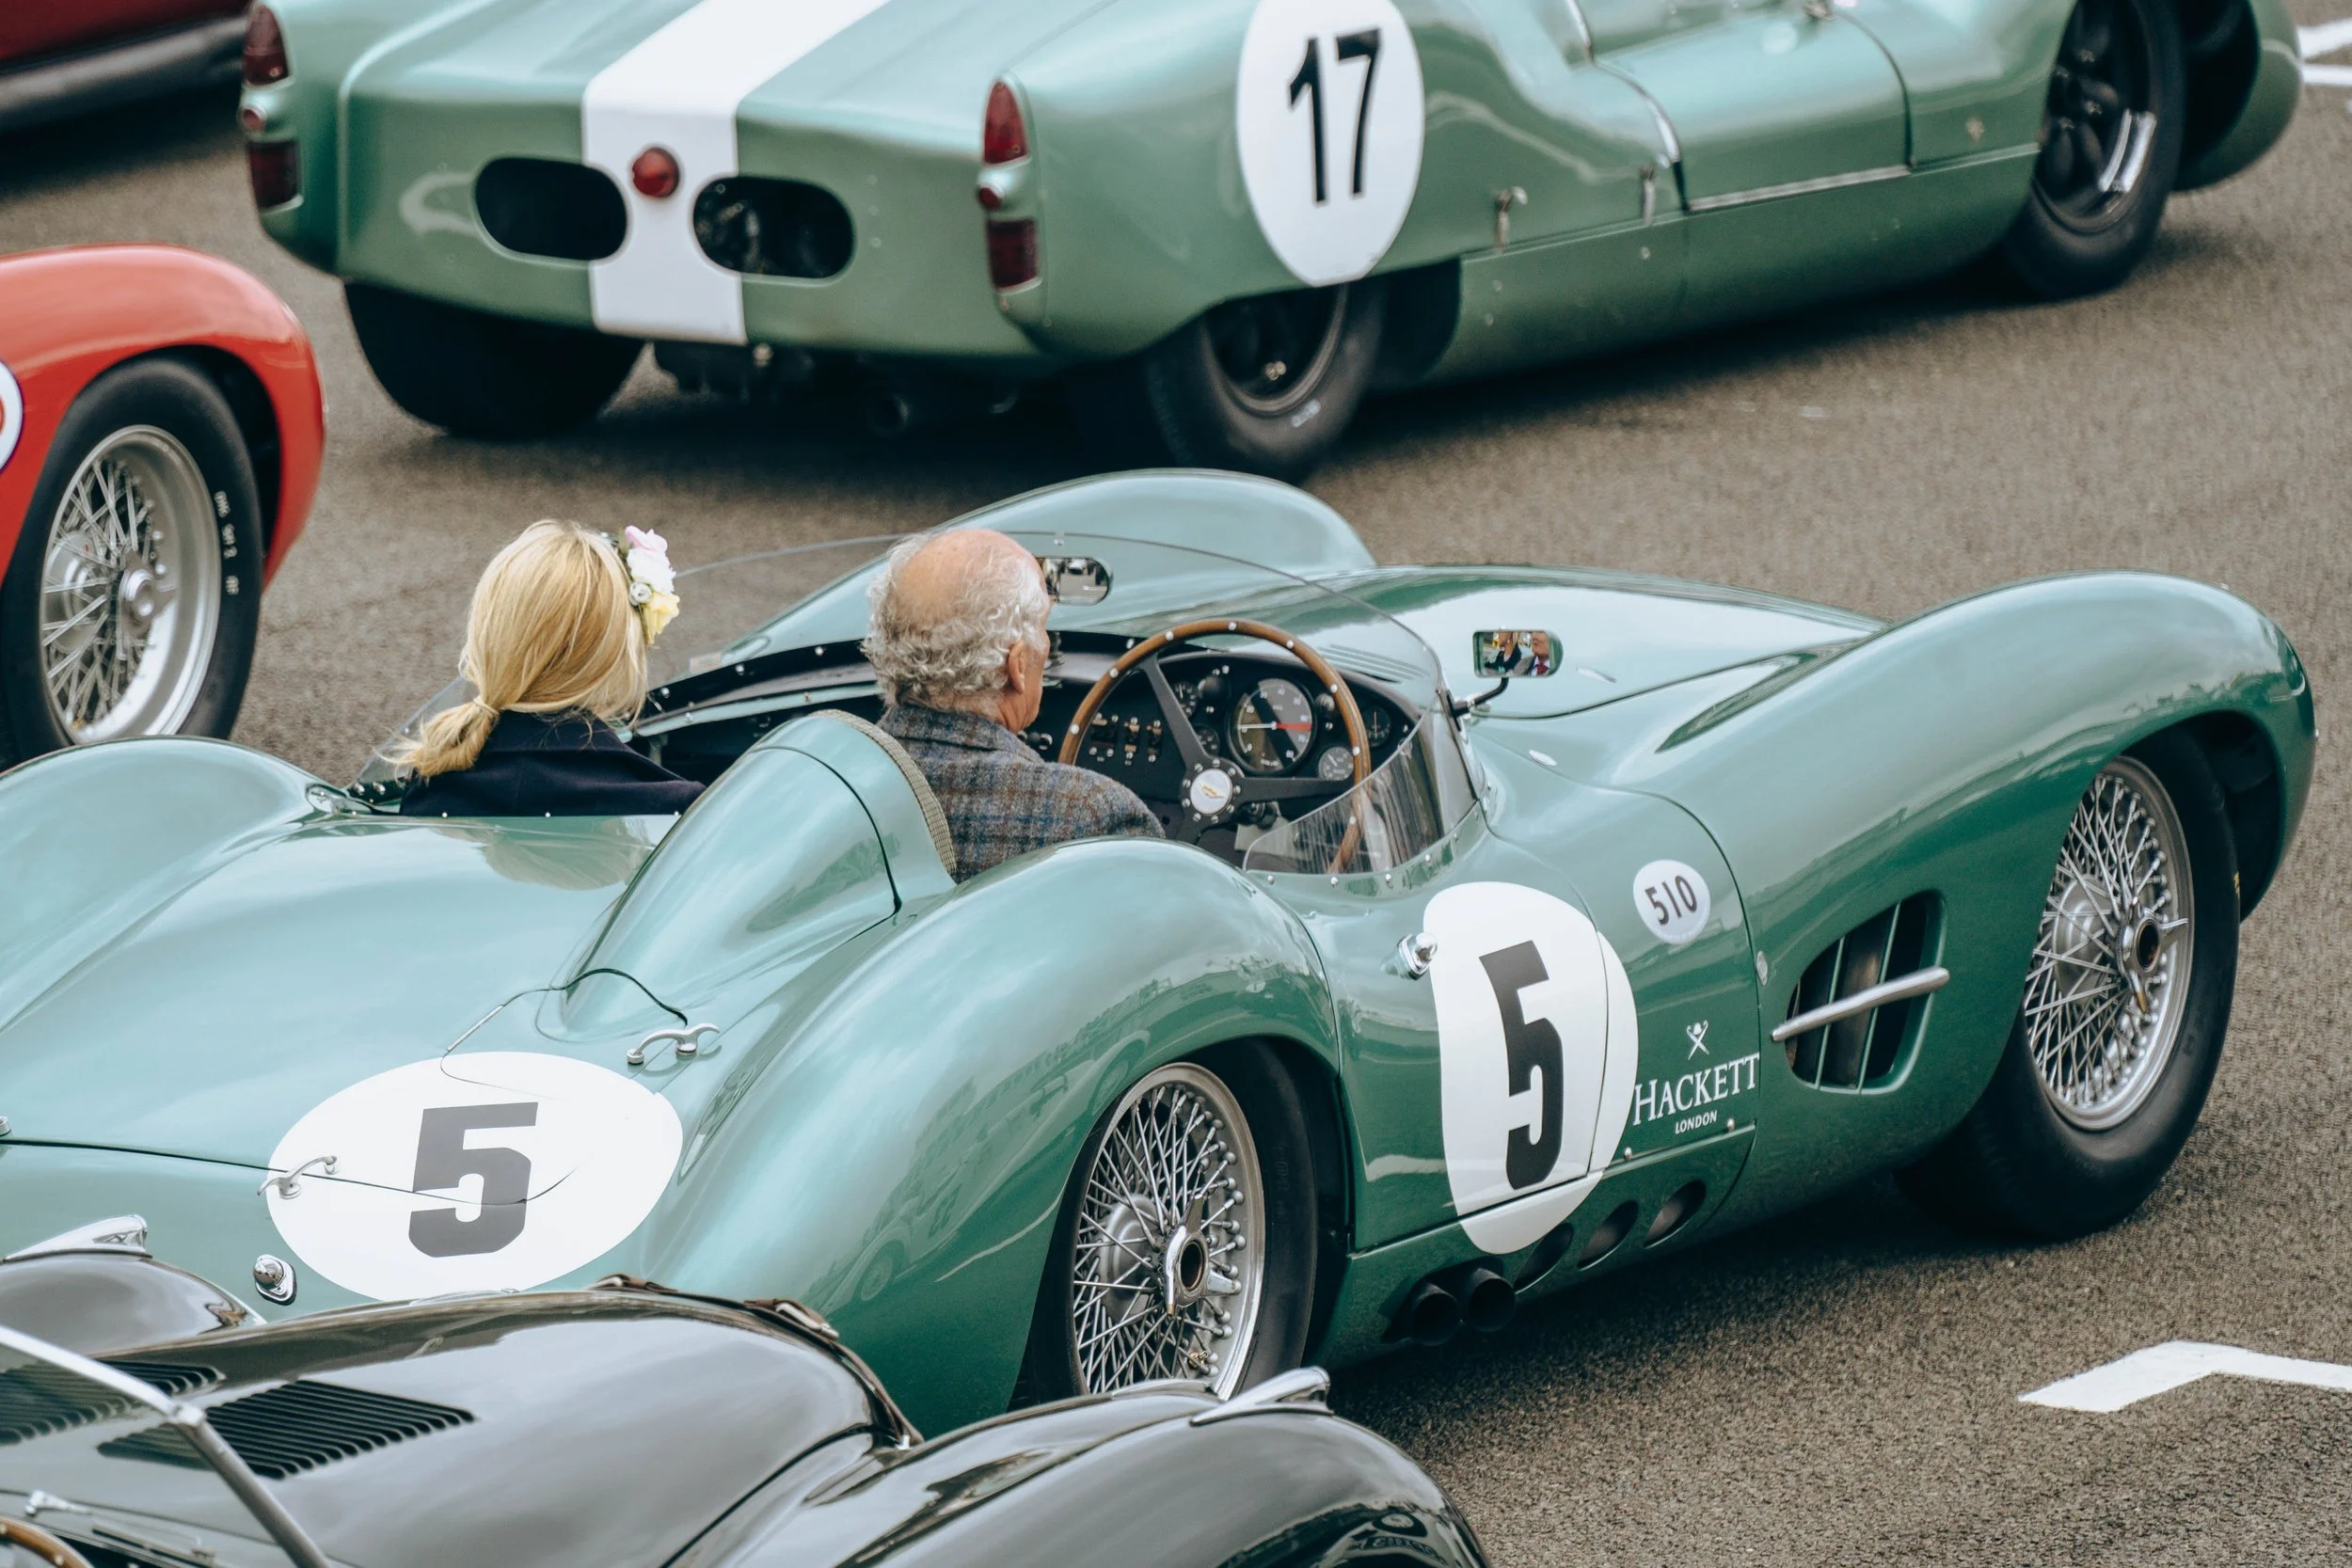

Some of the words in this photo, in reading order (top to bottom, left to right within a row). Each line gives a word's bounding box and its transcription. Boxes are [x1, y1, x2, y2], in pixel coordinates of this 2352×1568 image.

[1288, 29, 1381, 204] 17
[1645, 875, 1697, 926] 510
[1479, 940, 1565, 1191] 5
[1632, 1052, 1760, 1127] HACKETT
[1675, 1109, 1718, 1135] LONDON
[407, 1101, 539, 1259] 5
